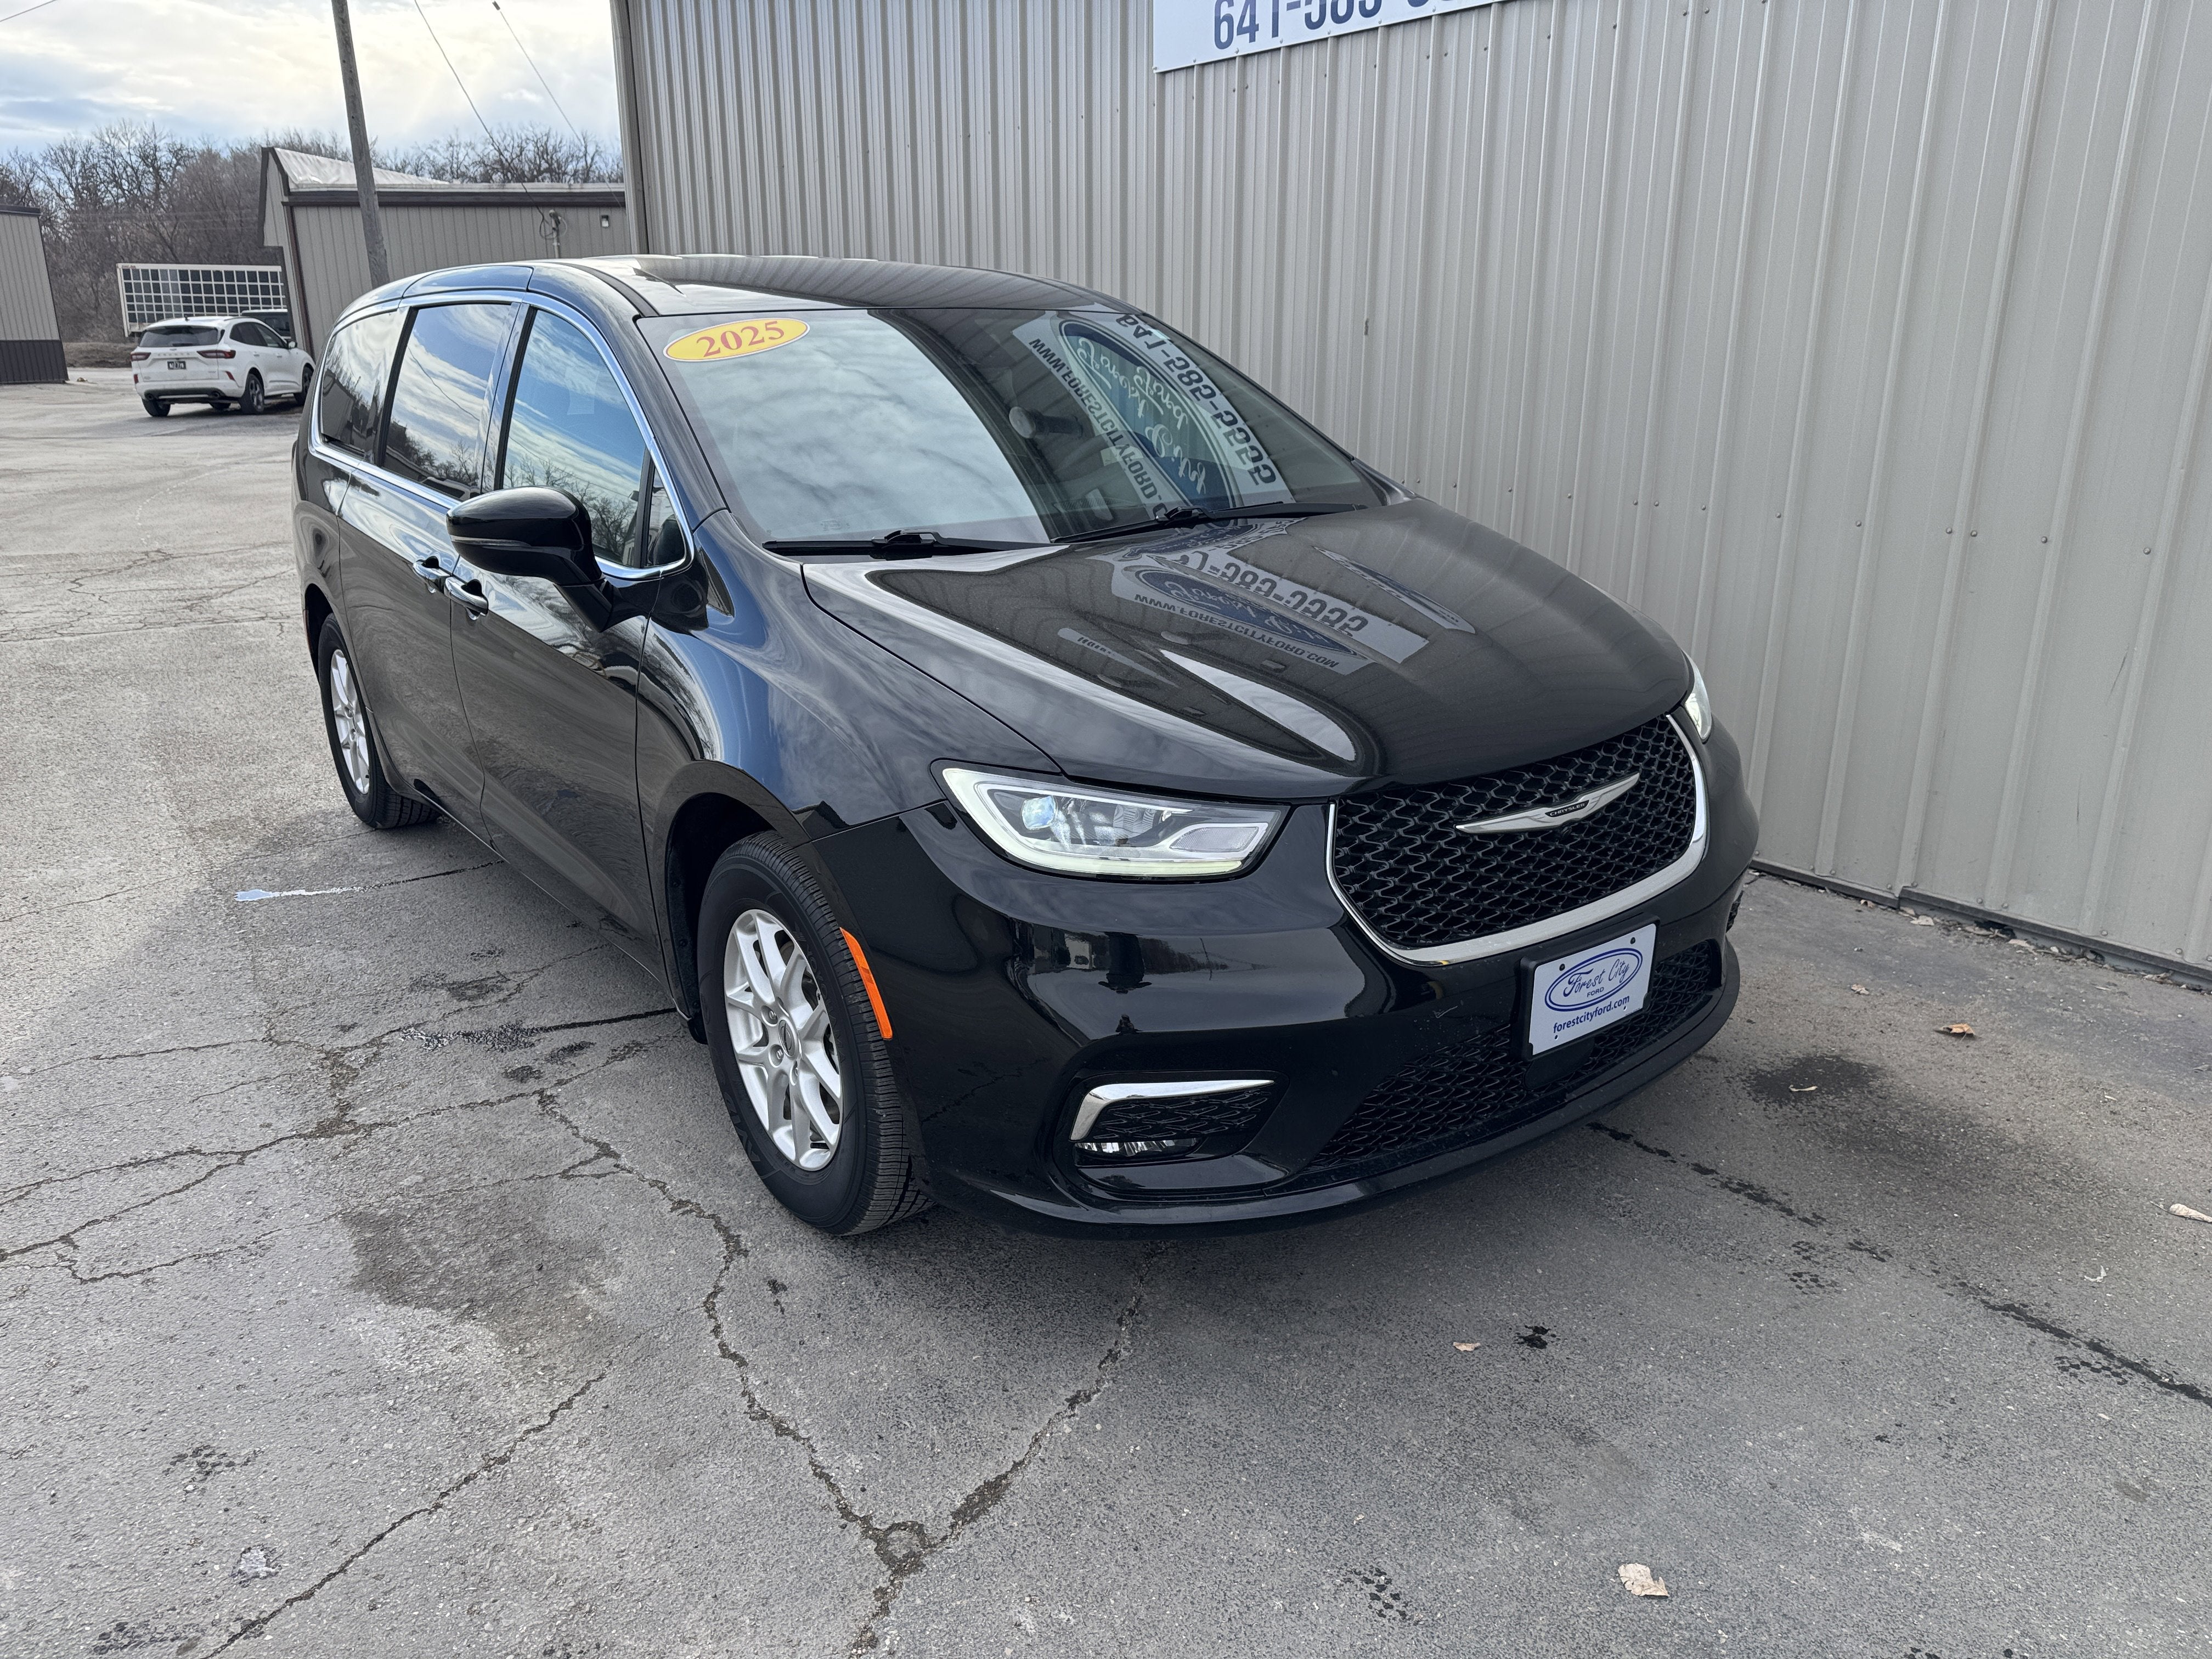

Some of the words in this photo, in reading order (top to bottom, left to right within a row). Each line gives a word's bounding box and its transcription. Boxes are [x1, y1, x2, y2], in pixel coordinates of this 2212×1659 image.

[696, 321, 785, 357] 2025
[1550, 803, 1585, 816] CHRYSLER
[1563, 968, 1606, 997] Forest
[1609, 958, 1629, 983] City
[1587, 986, 1604, 997] FORD
[1554, 996, 1629, 1033] forestcityford.com
